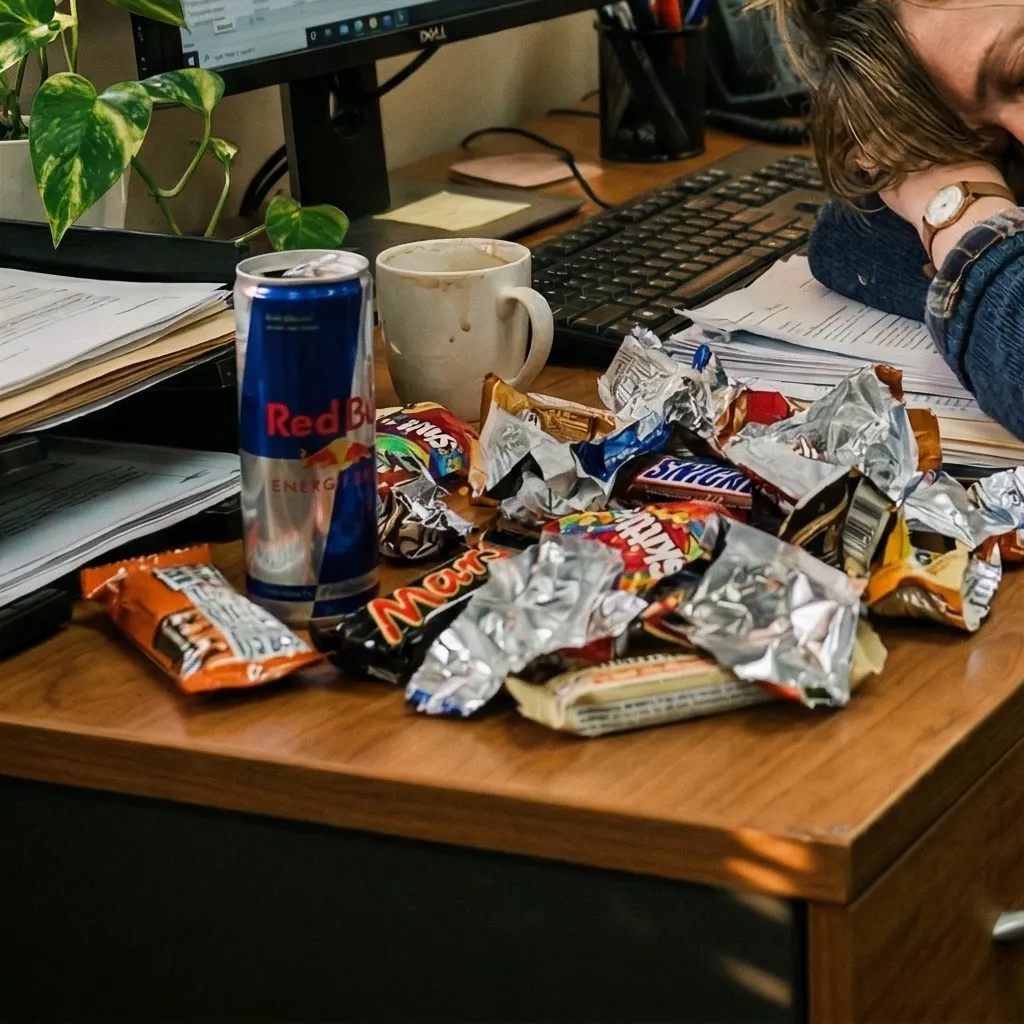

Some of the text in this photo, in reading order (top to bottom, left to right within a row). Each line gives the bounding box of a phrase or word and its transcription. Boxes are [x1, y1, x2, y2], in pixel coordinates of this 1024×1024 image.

[265, 396, 374, 437] Red Bu
[271, 477, 337, 494] ENERG
